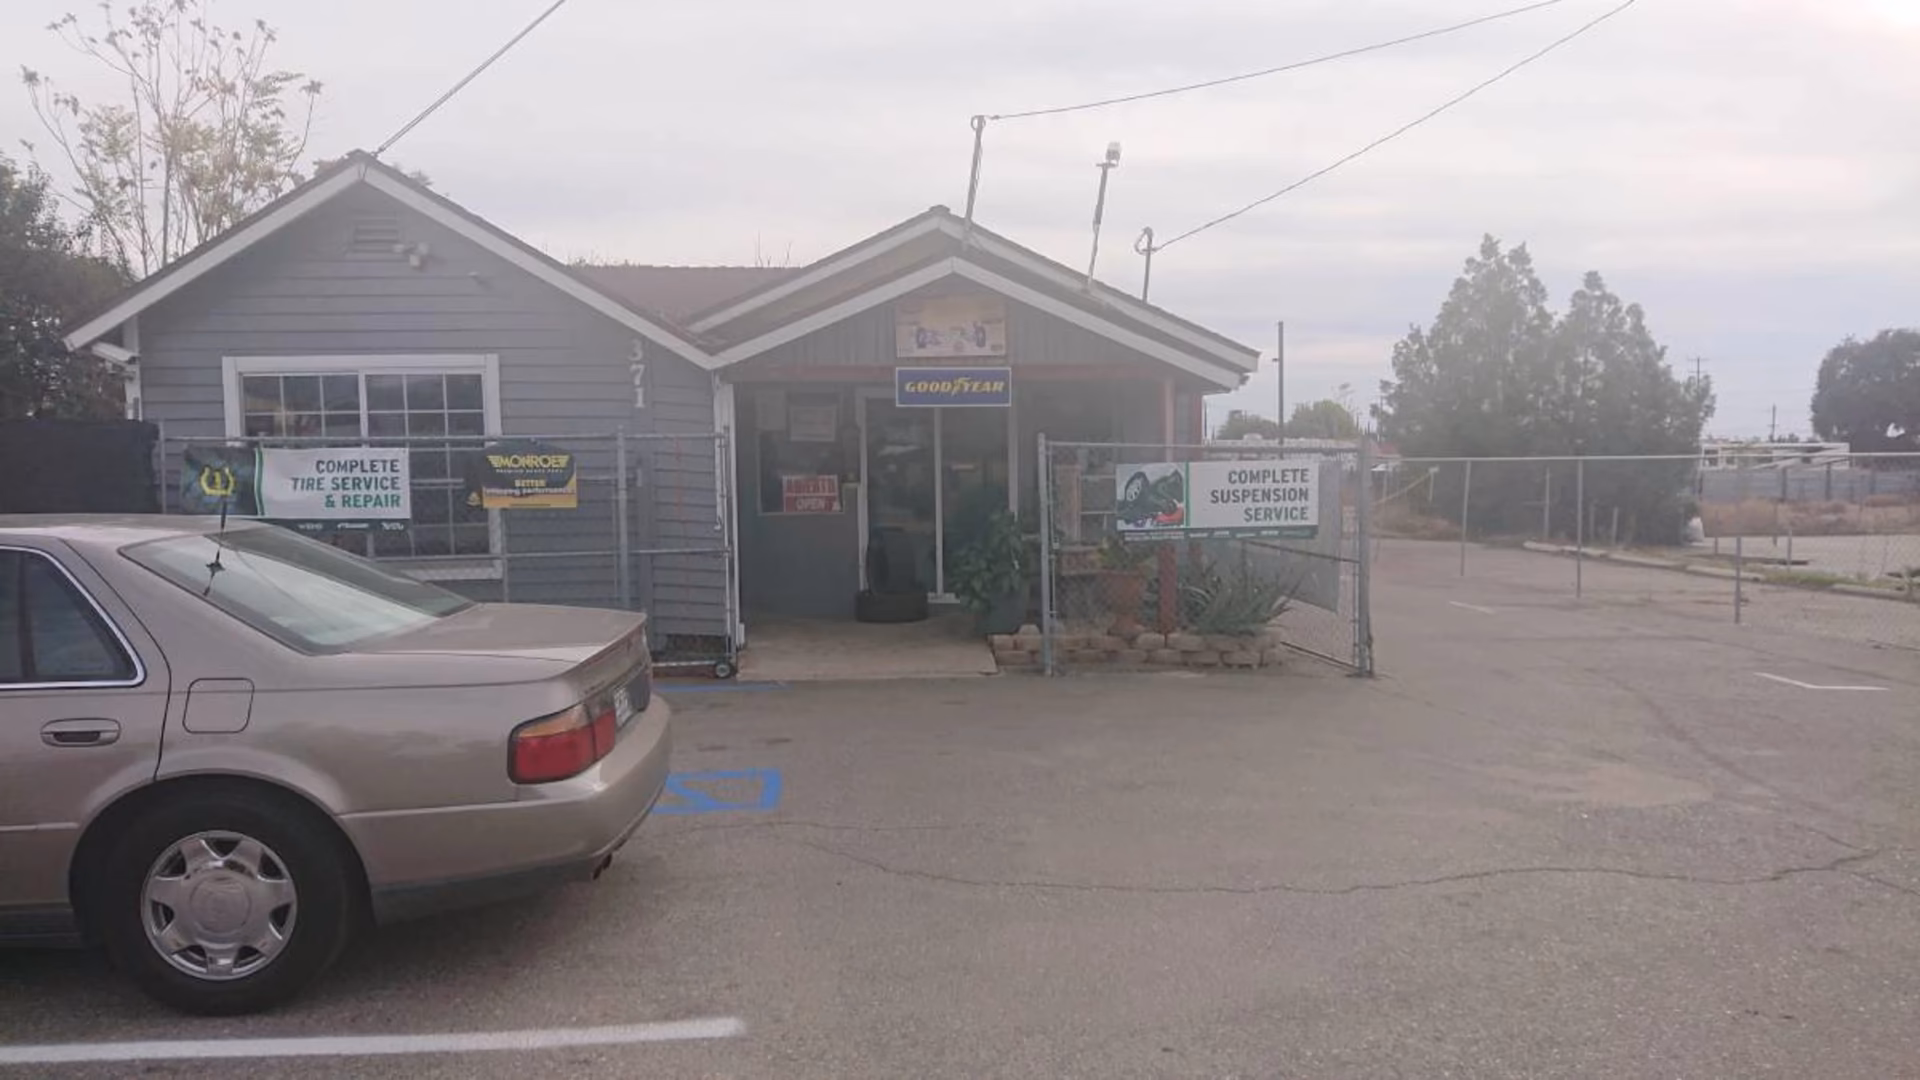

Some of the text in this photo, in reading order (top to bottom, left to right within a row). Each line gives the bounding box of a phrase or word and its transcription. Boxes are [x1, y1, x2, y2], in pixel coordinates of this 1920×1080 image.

[628, 338, 646, 409] 371
[904, 377, 1005, 397] GOODYEAR
[315, 459, 400, 474] COMPLETE
[499, 454, 561, 468] MONROE
[291, 476, 401, 491] TIRE SERVICE
[1228, 468, 1310, 485] COMPLETE
[325, 494, 401, 508] & REPAIR
[1210, 487, 1309, 504] SUSPENSION
[796, 498, 826, 511] OPEN
[1244, 506, 1309, 522] SERVICE
